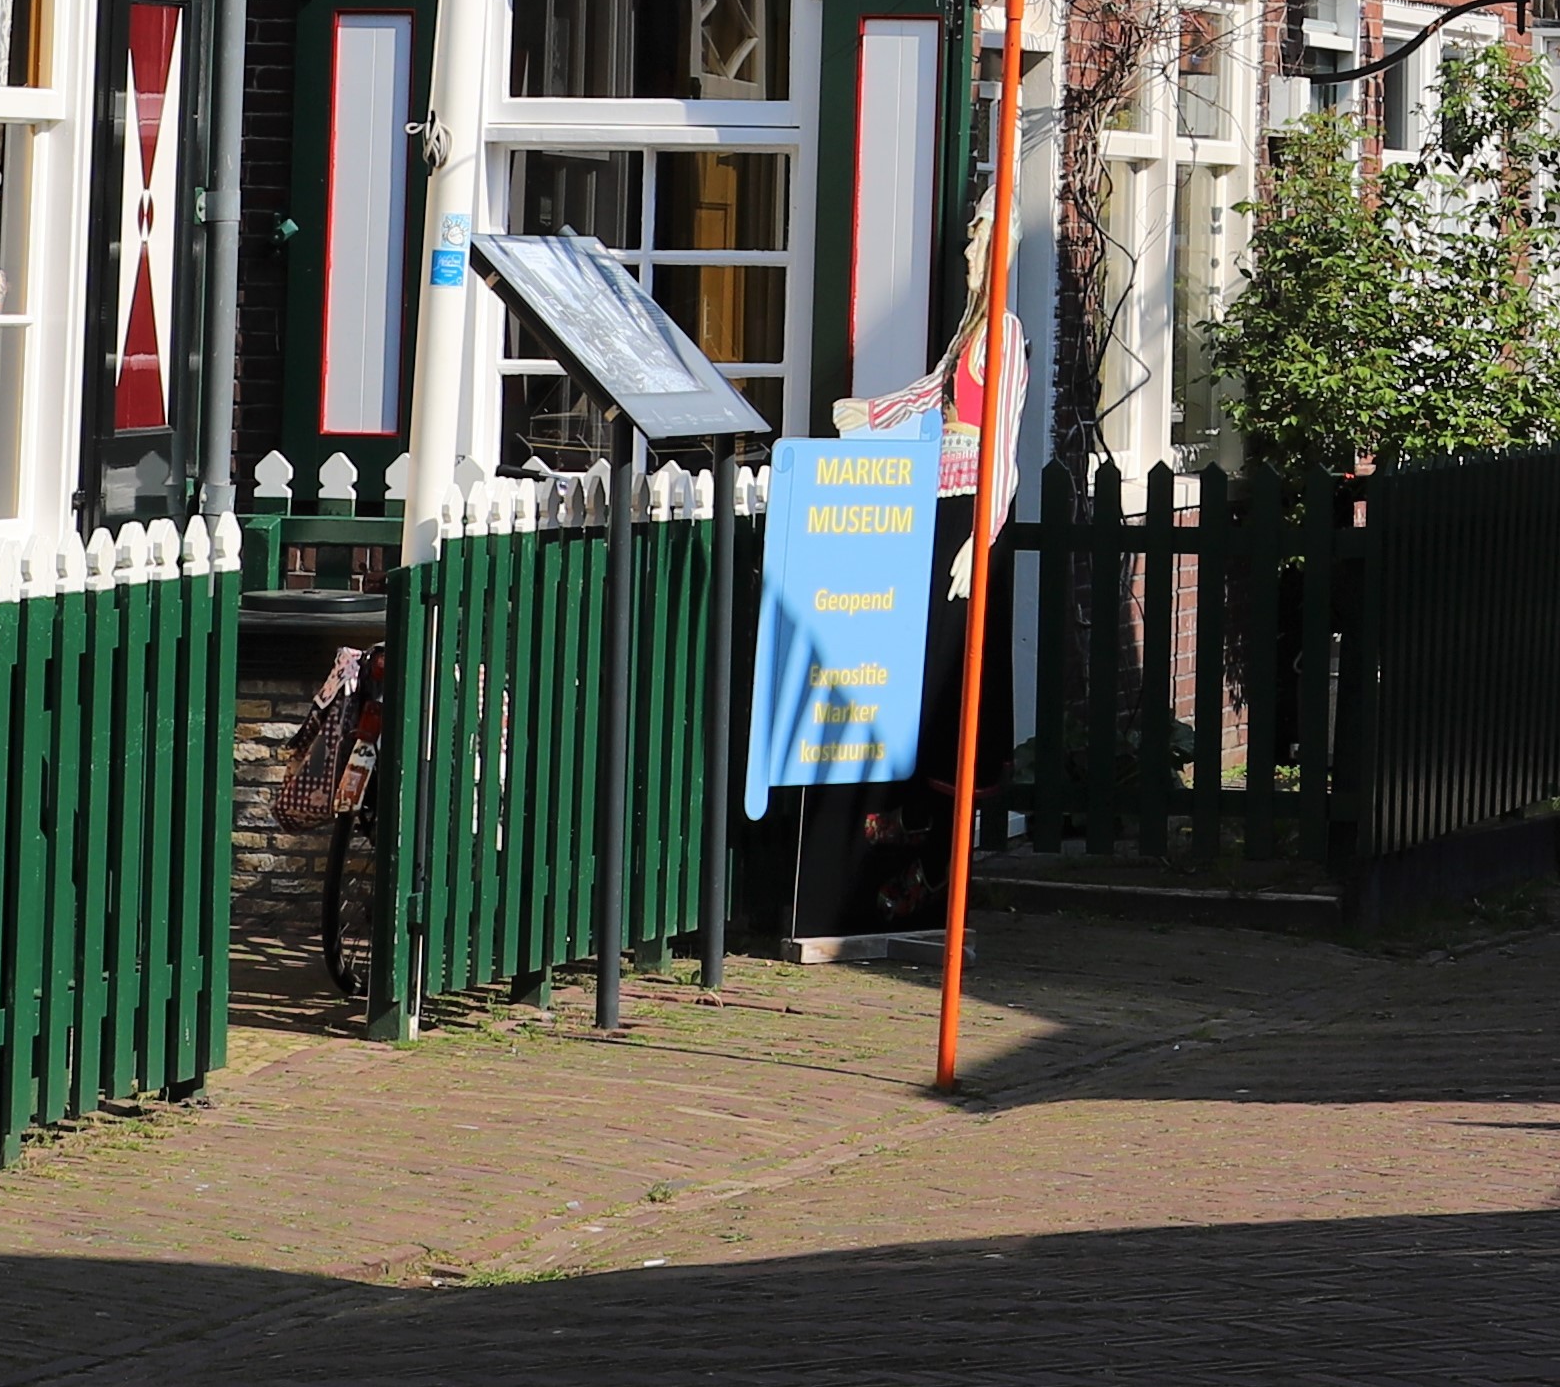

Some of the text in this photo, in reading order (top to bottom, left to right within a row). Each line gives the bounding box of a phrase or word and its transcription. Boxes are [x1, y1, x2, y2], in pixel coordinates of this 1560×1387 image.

[816, 457, 912, 485] MARKER
[807, 505, 913, 533] MUSEUM
[814, 587, 895, 615] Geopend
[809, 662, 888, 690] Expositie
[813, 700, 879, 724] Marker
[799, 739, 886, 764] kostuums
